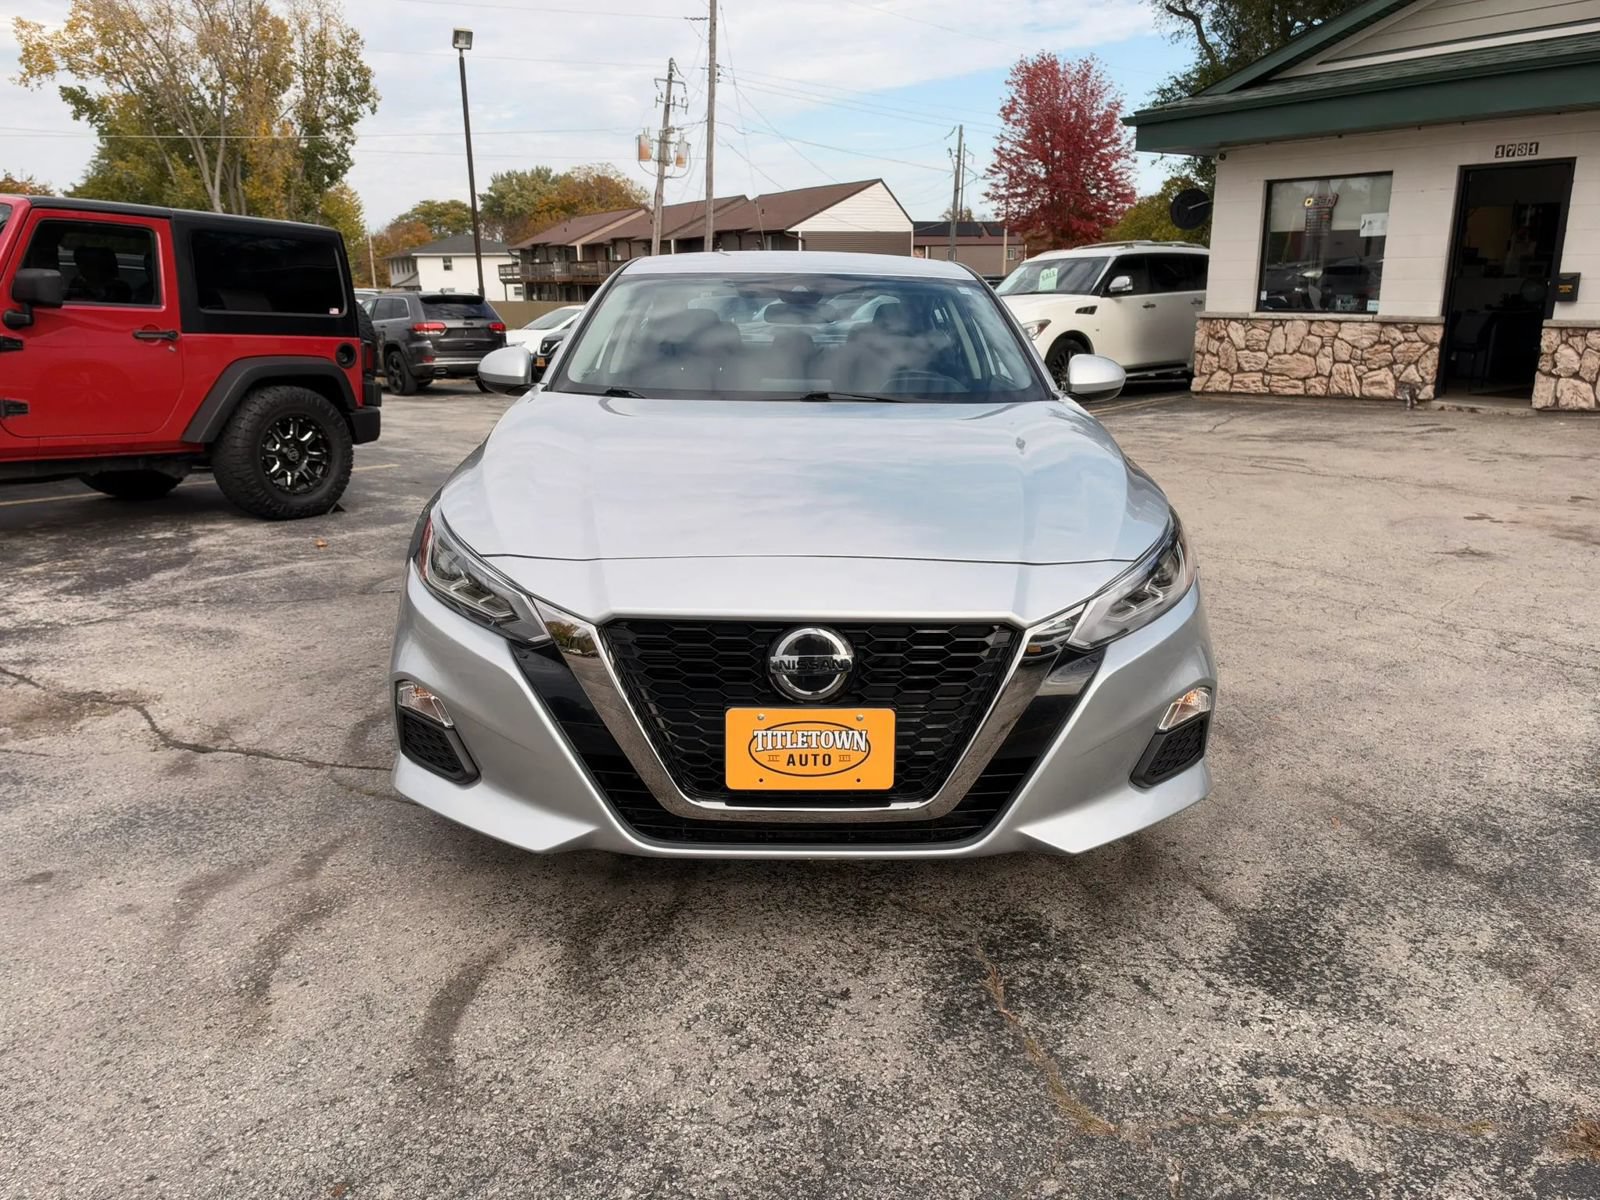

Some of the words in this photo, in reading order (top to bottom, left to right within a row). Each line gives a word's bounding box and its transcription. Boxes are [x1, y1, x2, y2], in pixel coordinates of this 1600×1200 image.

[779, 659, 843, 671] NISSAN
[753, 729, 868, 752] TITLETOWN
[786, 753, 832, 767] AUTO
